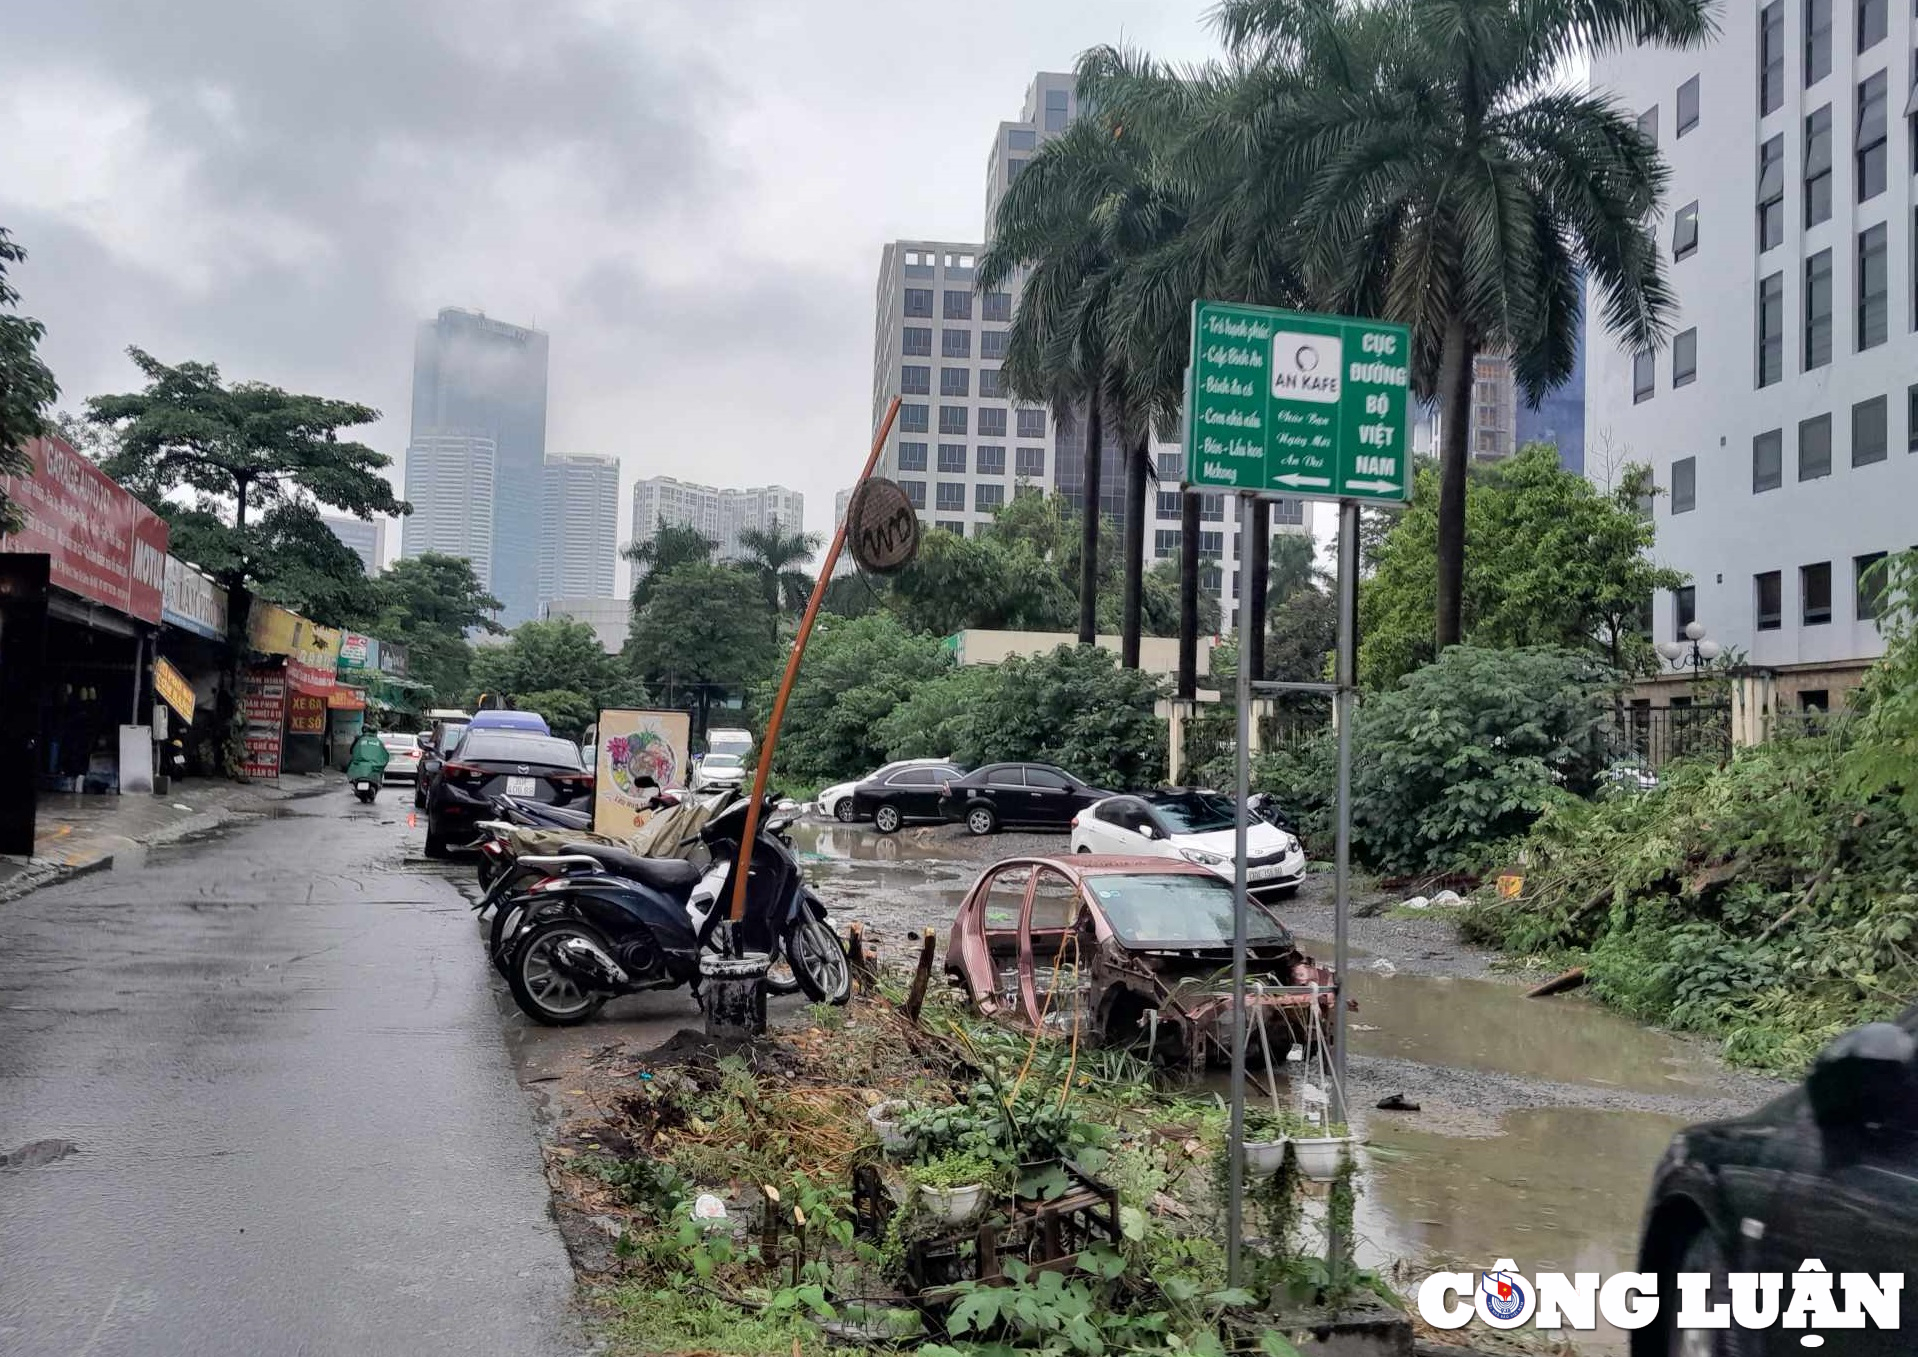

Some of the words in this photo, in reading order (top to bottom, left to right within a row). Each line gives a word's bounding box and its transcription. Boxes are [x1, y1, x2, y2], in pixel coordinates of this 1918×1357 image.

[1362, 333, 1397, 357] CỤC
[1275, 373, 1297, 389] AN
[1302, 375, 1337, 393] KAFE
[1350, 361, 1407, 387] ĐƯỜNG
[1365, 392, 1390, 419] BỘ
[1358, 422, 1395, 449] VIỆT
[1355, 455, 1396, 476] NAM
[293, 698, 307, 710] XE
[292, 716, 307, 729] XE
